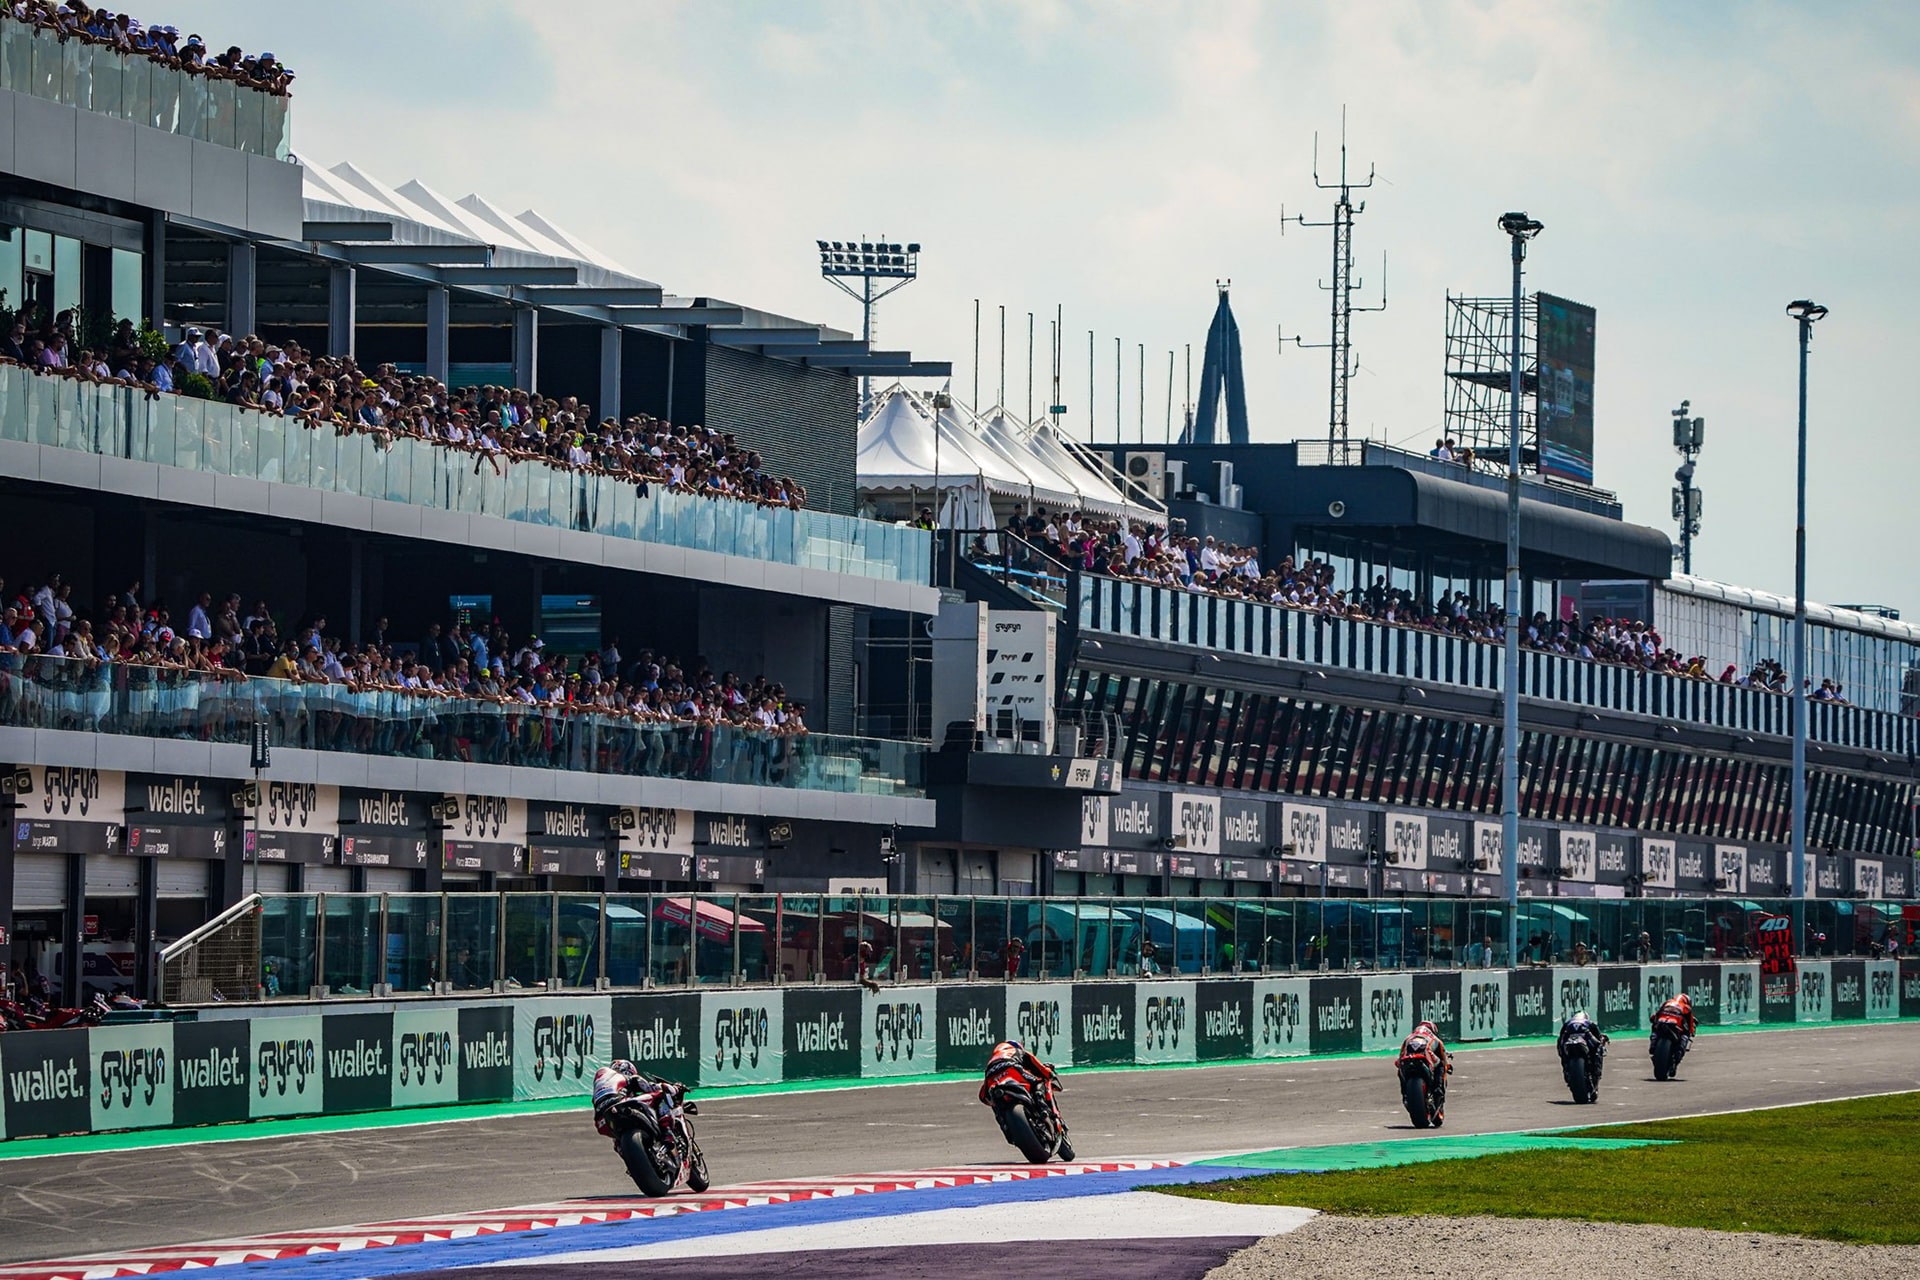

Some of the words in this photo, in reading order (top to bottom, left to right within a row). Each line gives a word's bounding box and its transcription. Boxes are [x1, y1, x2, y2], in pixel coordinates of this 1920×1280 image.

[148, 779, 205, 815] wallet.
[359, 792, 409, 827] wallet.
[545, 805, 589, 838] wallet.
[709, 815, 750, 847] wallet.
[1114, 801, 1153, 834] wallet.
[1225, 811, 1261, 843] wallet.
[1331, 820, 1363, 850] wallet.
[1432, 829, 1462, 859] wallet.
[1599, 844, 1626, 872] wallet.
[1318, 997, 1354, 1032] wallet.
[1420, 991, 1454, 1023] wallet.
[1515, 985, 1546, 1017] wallet.
[1604, 981, 1634, 1013] wallet.
[796, 1011, 849, 1053] wallet.
[948, 1007, 996, 1047] wallet.
[1082, 1004, 1126, 1043] wallet.
[1205, 1001, 1244, 1037] wallet.
[464, 1031, 511, 1070] wallet.
[627, 1017, 686, 1062] wallet.
[180, 1047, 244, 1090] wallet.
[328, 1039, 387, 1079] wallet.
[10, 1057, 84, 1103] wallet.
